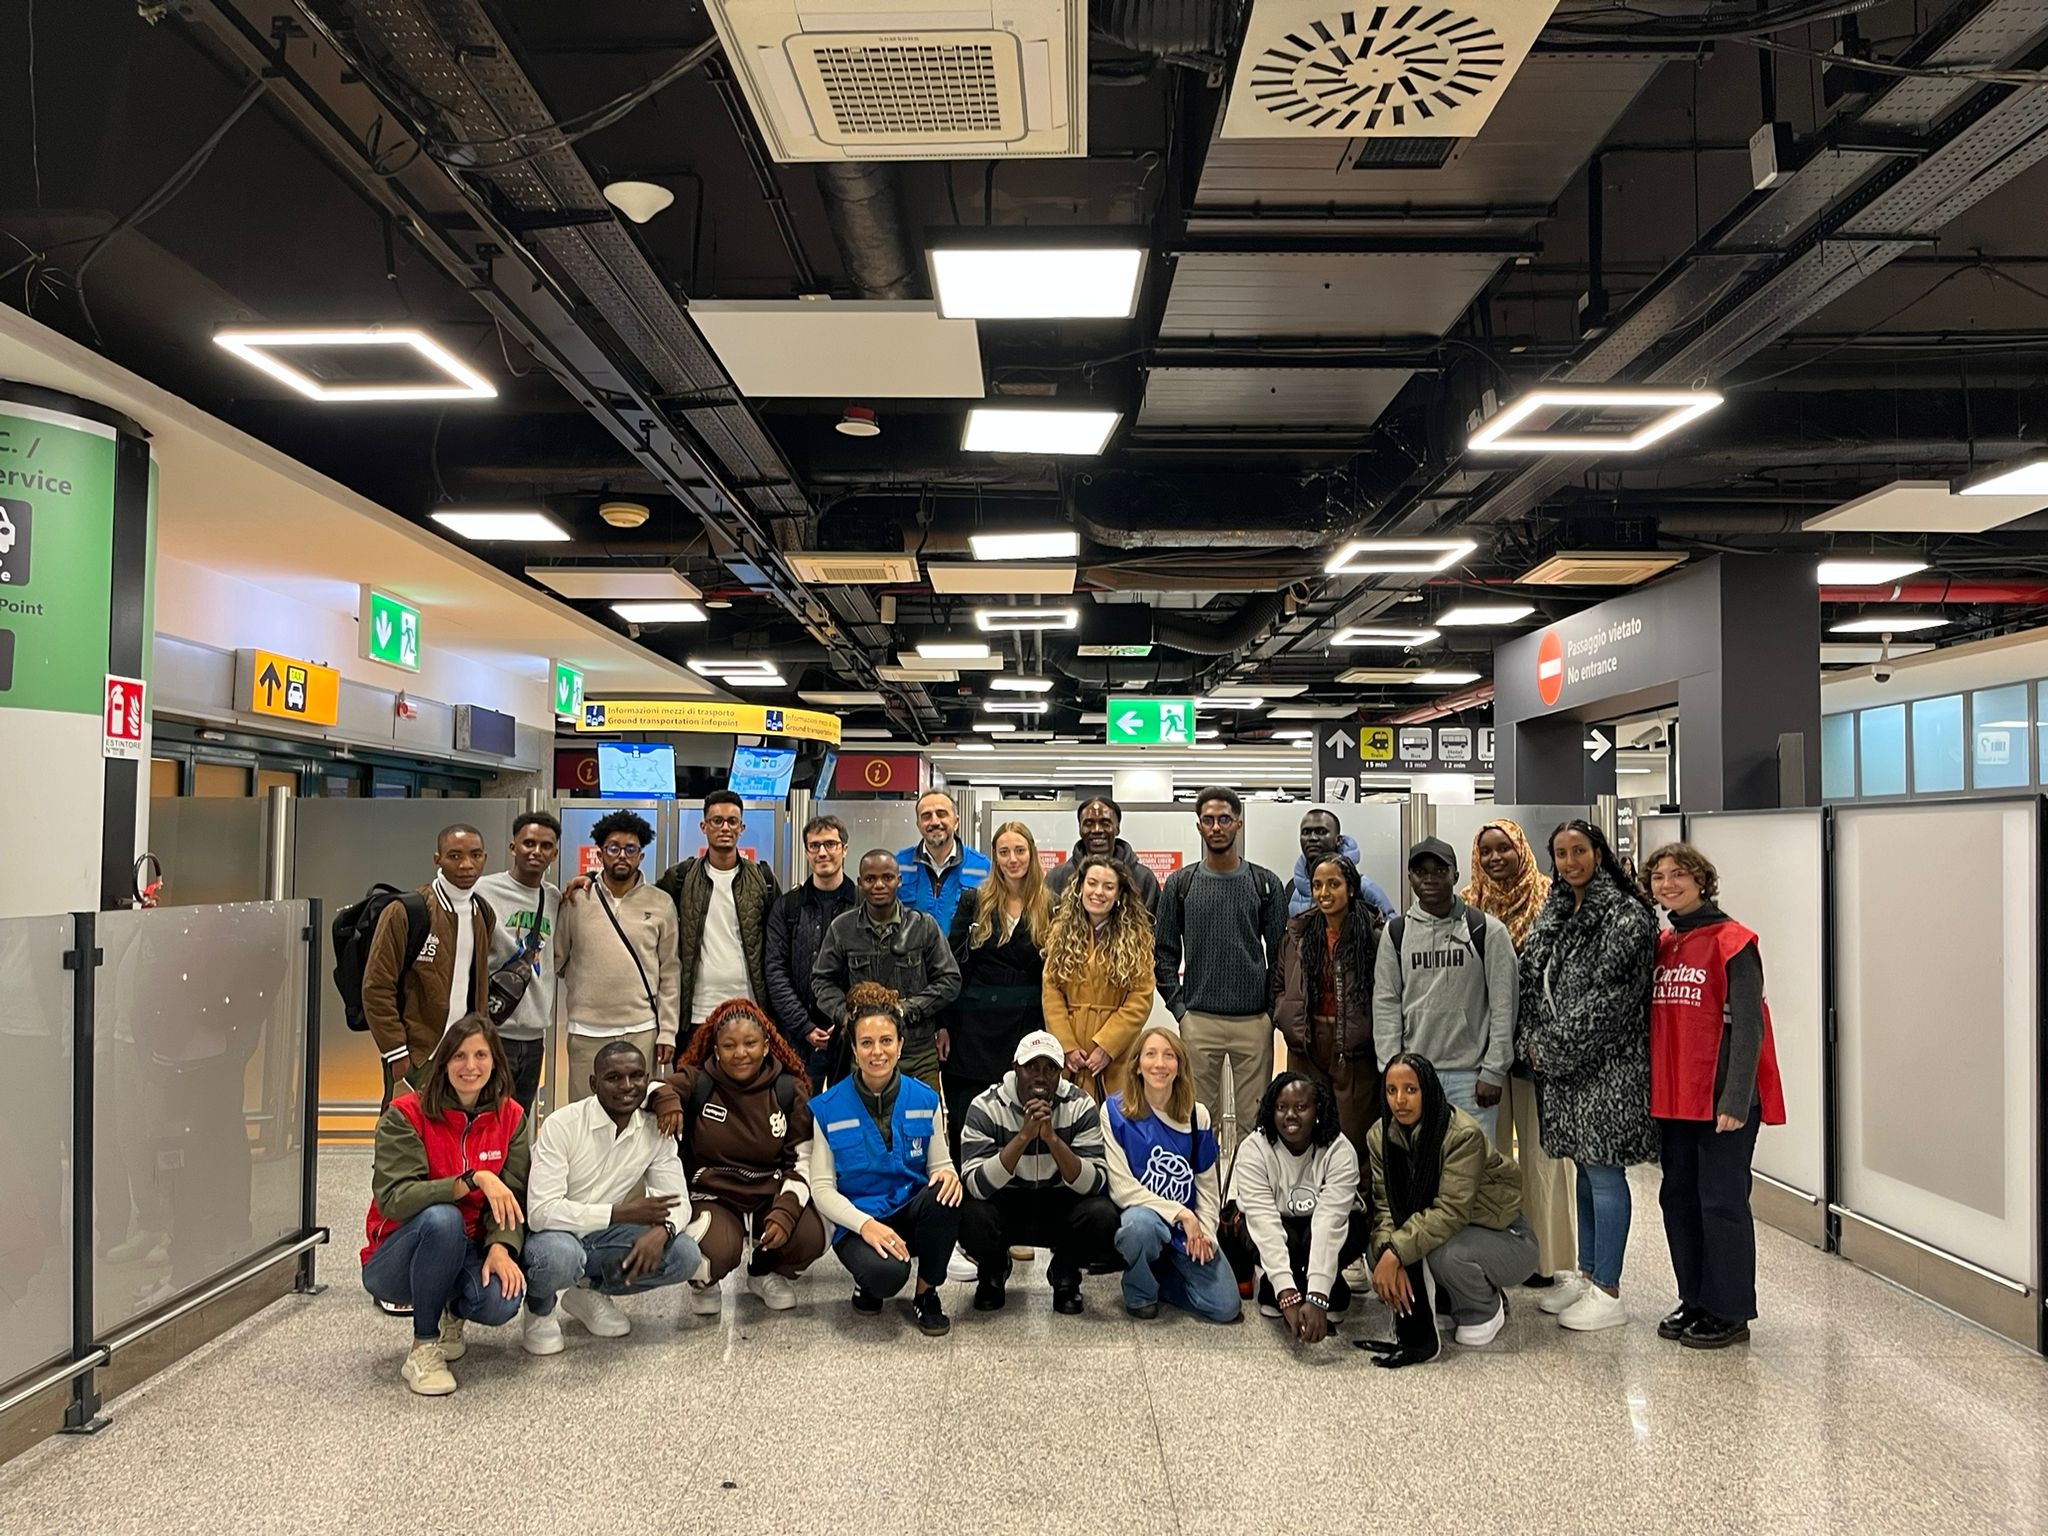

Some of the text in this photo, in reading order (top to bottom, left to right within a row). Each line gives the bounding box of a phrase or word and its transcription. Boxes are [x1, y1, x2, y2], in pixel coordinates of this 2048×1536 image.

[0, 598, 43, 616] Point
[1567, 617, 1642, 658] Passaggio vietato
[1567, 656, 1617, 685] No entrance
[608, 707, 735, 718] Informazioni mezzi di trasporto
[608, 717, 738, 728] Ground transportation infopoint
[105, 739, 142, 750] ESTINTORE
[1411, 949, 1464, 970] PUMA
[1653, 963, 1706, 985] Caritas
